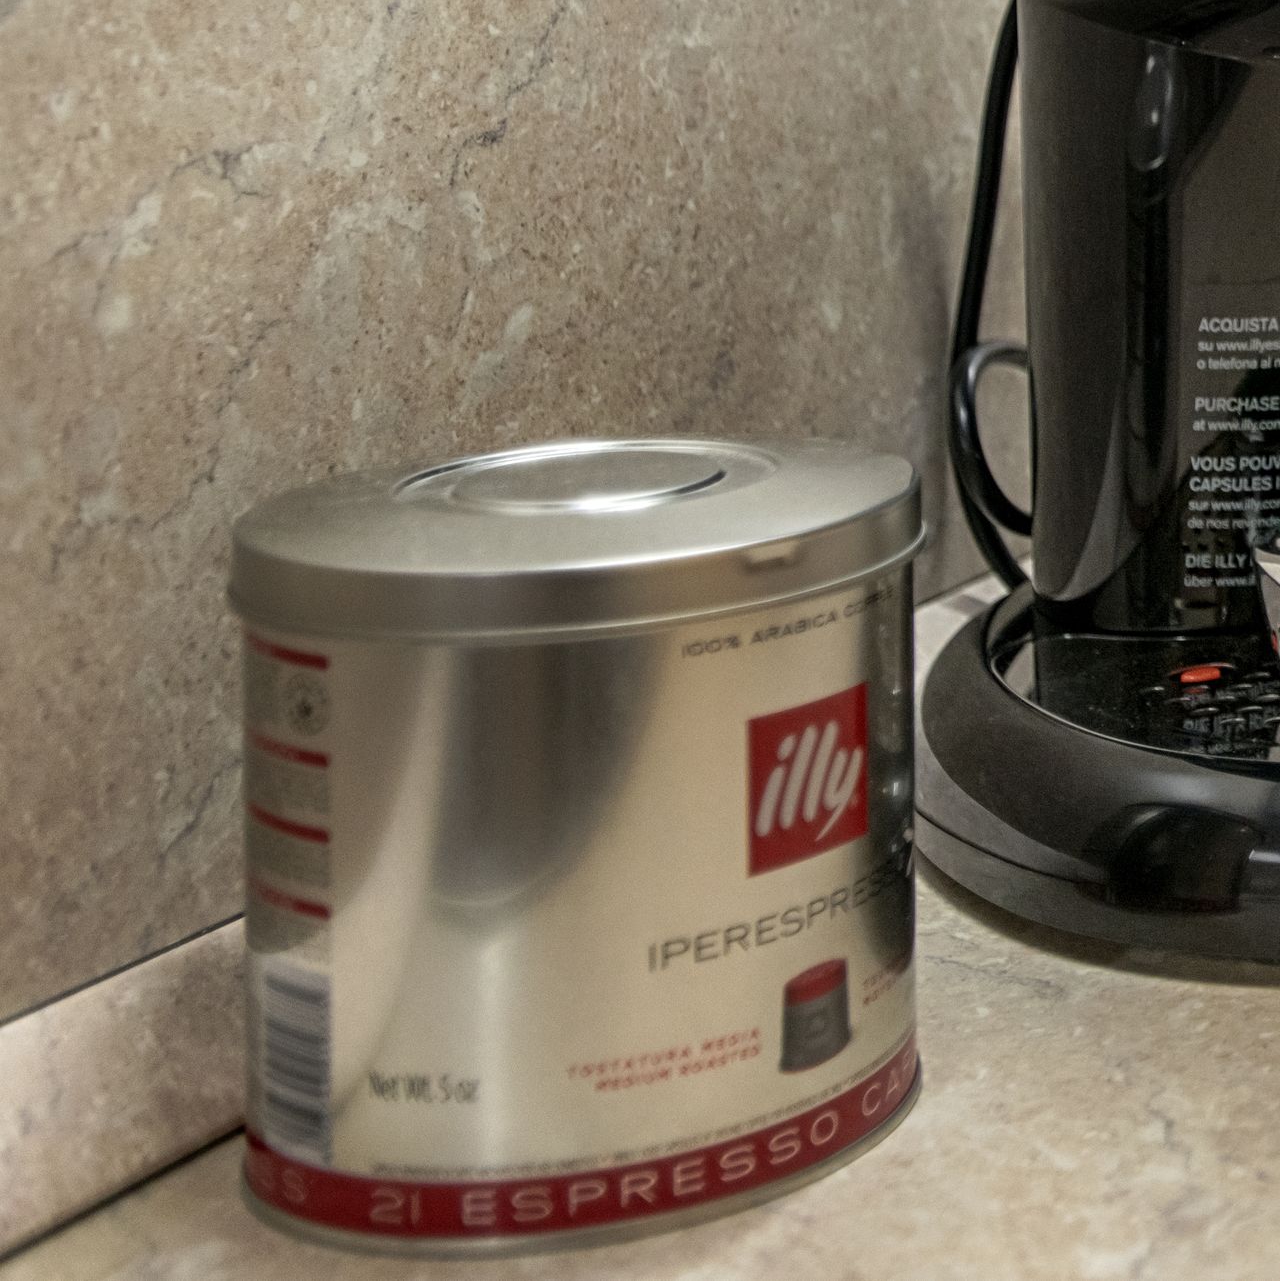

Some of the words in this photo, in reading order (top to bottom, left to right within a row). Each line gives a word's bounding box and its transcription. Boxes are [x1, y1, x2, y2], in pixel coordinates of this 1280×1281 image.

[1198, 316, 1279, 332] ACQUISTA
[1197, 341, 1214, 351] su
[1196, 359, 1207, 370] o
[1260, 356, 1272, 369] al
[1194, 395, 1280, 412] PURCHASE
[1192, 419, 1206, 431] at
[1190, 456, 1236, 472] VOUS
[1188, 476, 1273, 492] CAPSULES
[1188, 500, 1209, 511] sur
[1187, 517, 1204, 529] de
[1205, 518, 1230, 529] nos
[1185, 553, 1212, 568] DIE
[1214, 553, 1248, 568] ILLY
[682, 633, 742, 658] 100%
[750, 610, 838, 645] ARABICA
[755, 720, 864, 842] illy
[461, 1110, 840, 1227] ESPRESSO
